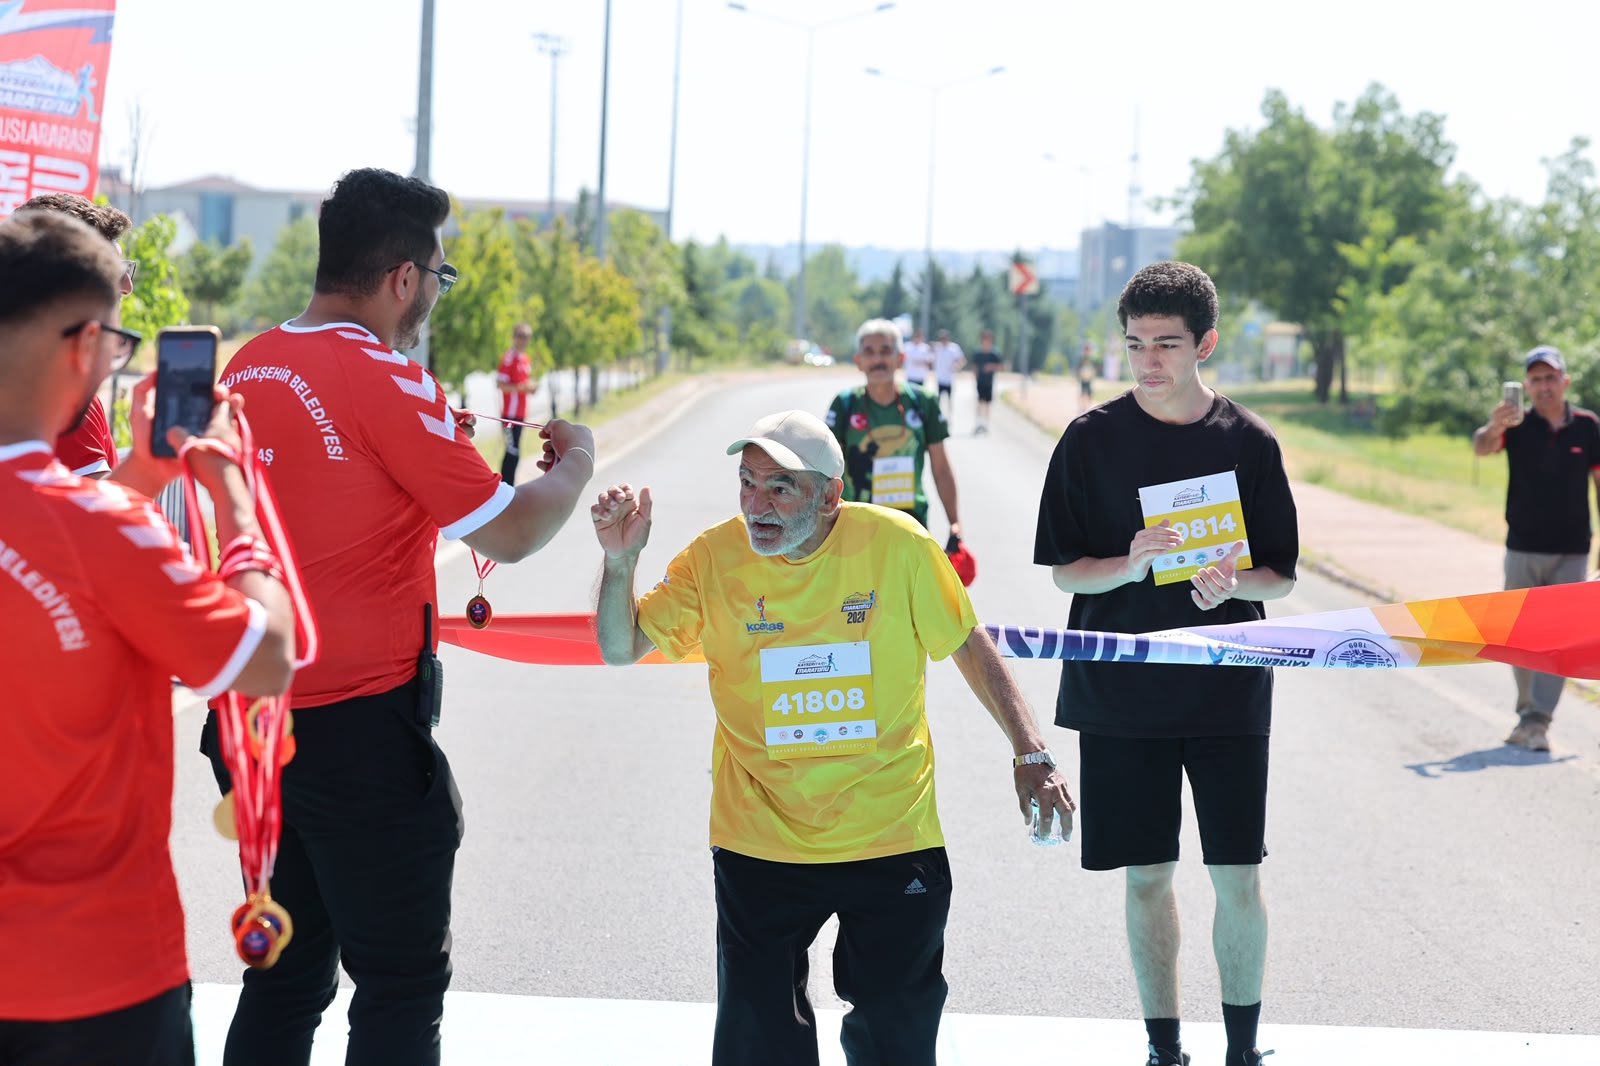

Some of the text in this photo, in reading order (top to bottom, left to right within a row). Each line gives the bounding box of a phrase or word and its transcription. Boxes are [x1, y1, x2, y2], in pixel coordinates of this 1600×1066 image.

[289, 374, 349, 461] BELEDİYESİ
[1172, 512, 1237, 541] 9814
[986, 623, 1150, 663] FINIS
[772, 688, 865, 715] 41808
[904, 887, 927, 895] adidas
